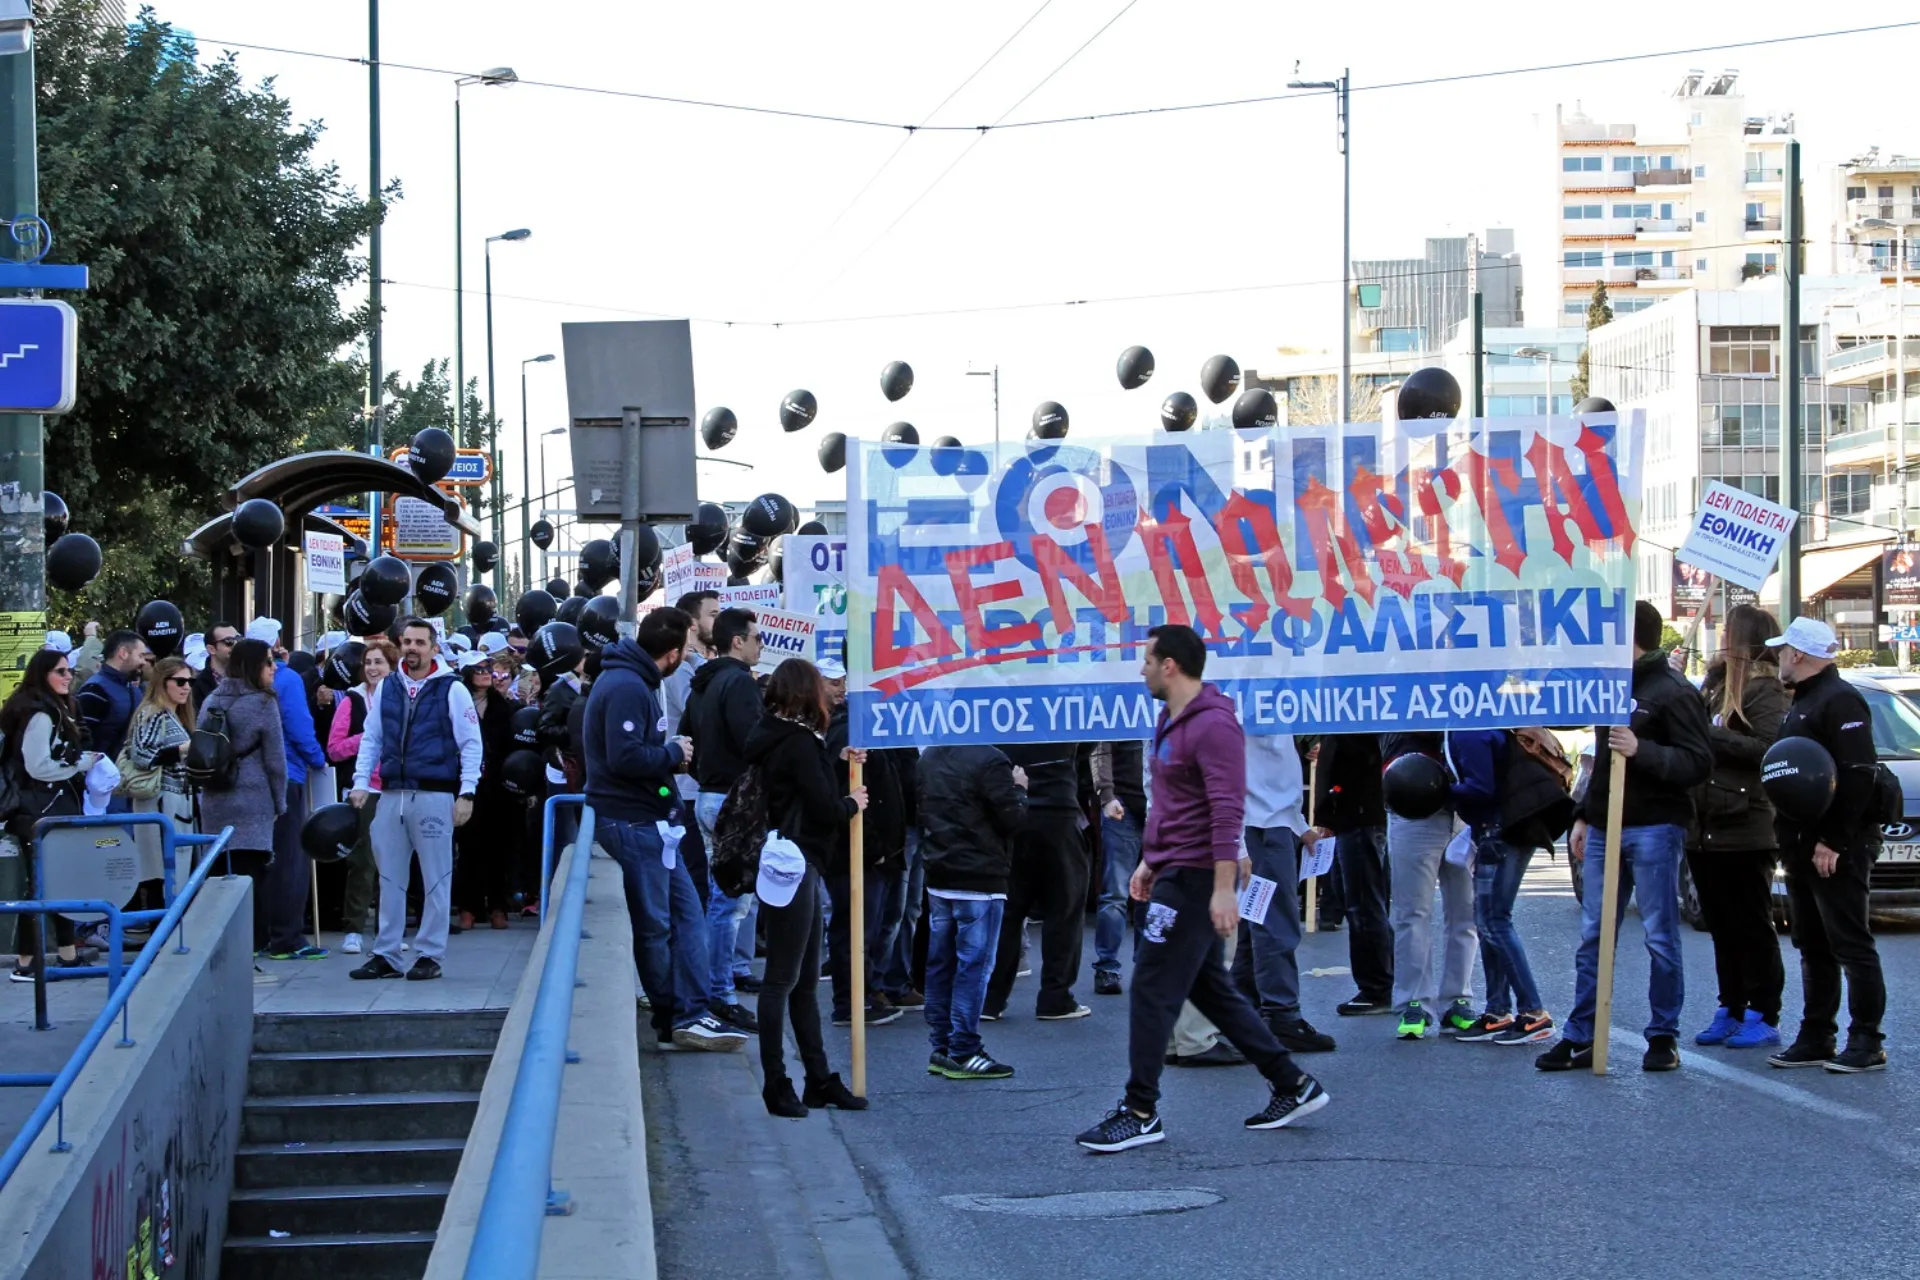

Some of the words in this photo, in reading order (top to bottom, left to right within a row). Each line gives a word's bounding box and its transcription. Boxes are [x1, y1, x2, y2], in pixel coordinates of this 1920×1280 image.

[1705, 490, 1734, 512] ΔΕΝ
[1732, 500, 1791, 533] ΠΩΛΕΙΤΑΙ
[1699, 512, 1776, 555] ΕΘΝΙΚΗ
[311, 554, 342, 570] ΕΘΝΙΚΗ
[694, 566, 728, 577] ΩΛΕΙΤΑΙ
[718, 593, 732, 602] ΕΝ
[734, 588, 778, 602] ΠΩΛΕΙΤΑΙ
[872, 523, 1131, 672] ΔΕΝ
[147, 628, 178, 636] ΠΩΛΕΙΤΑΙ
[760, 613, 815, 635] ΠΩΛΕΙΤΑΙ
[760, 630, 805, 652] ΝΙΚΗ
[872, 697, 1035, 737] ΣΥΛΛΟΓΟΣ
[1255, 685, 1399, 725] ΕΘΝΙΚΗΣ
[1407, 678, 1628, 719] ΑΣΦΑΛΙΣΤΙΚΗΣ
[1244, 880, 1262, 916] ΕΘΝΙΚΗ
